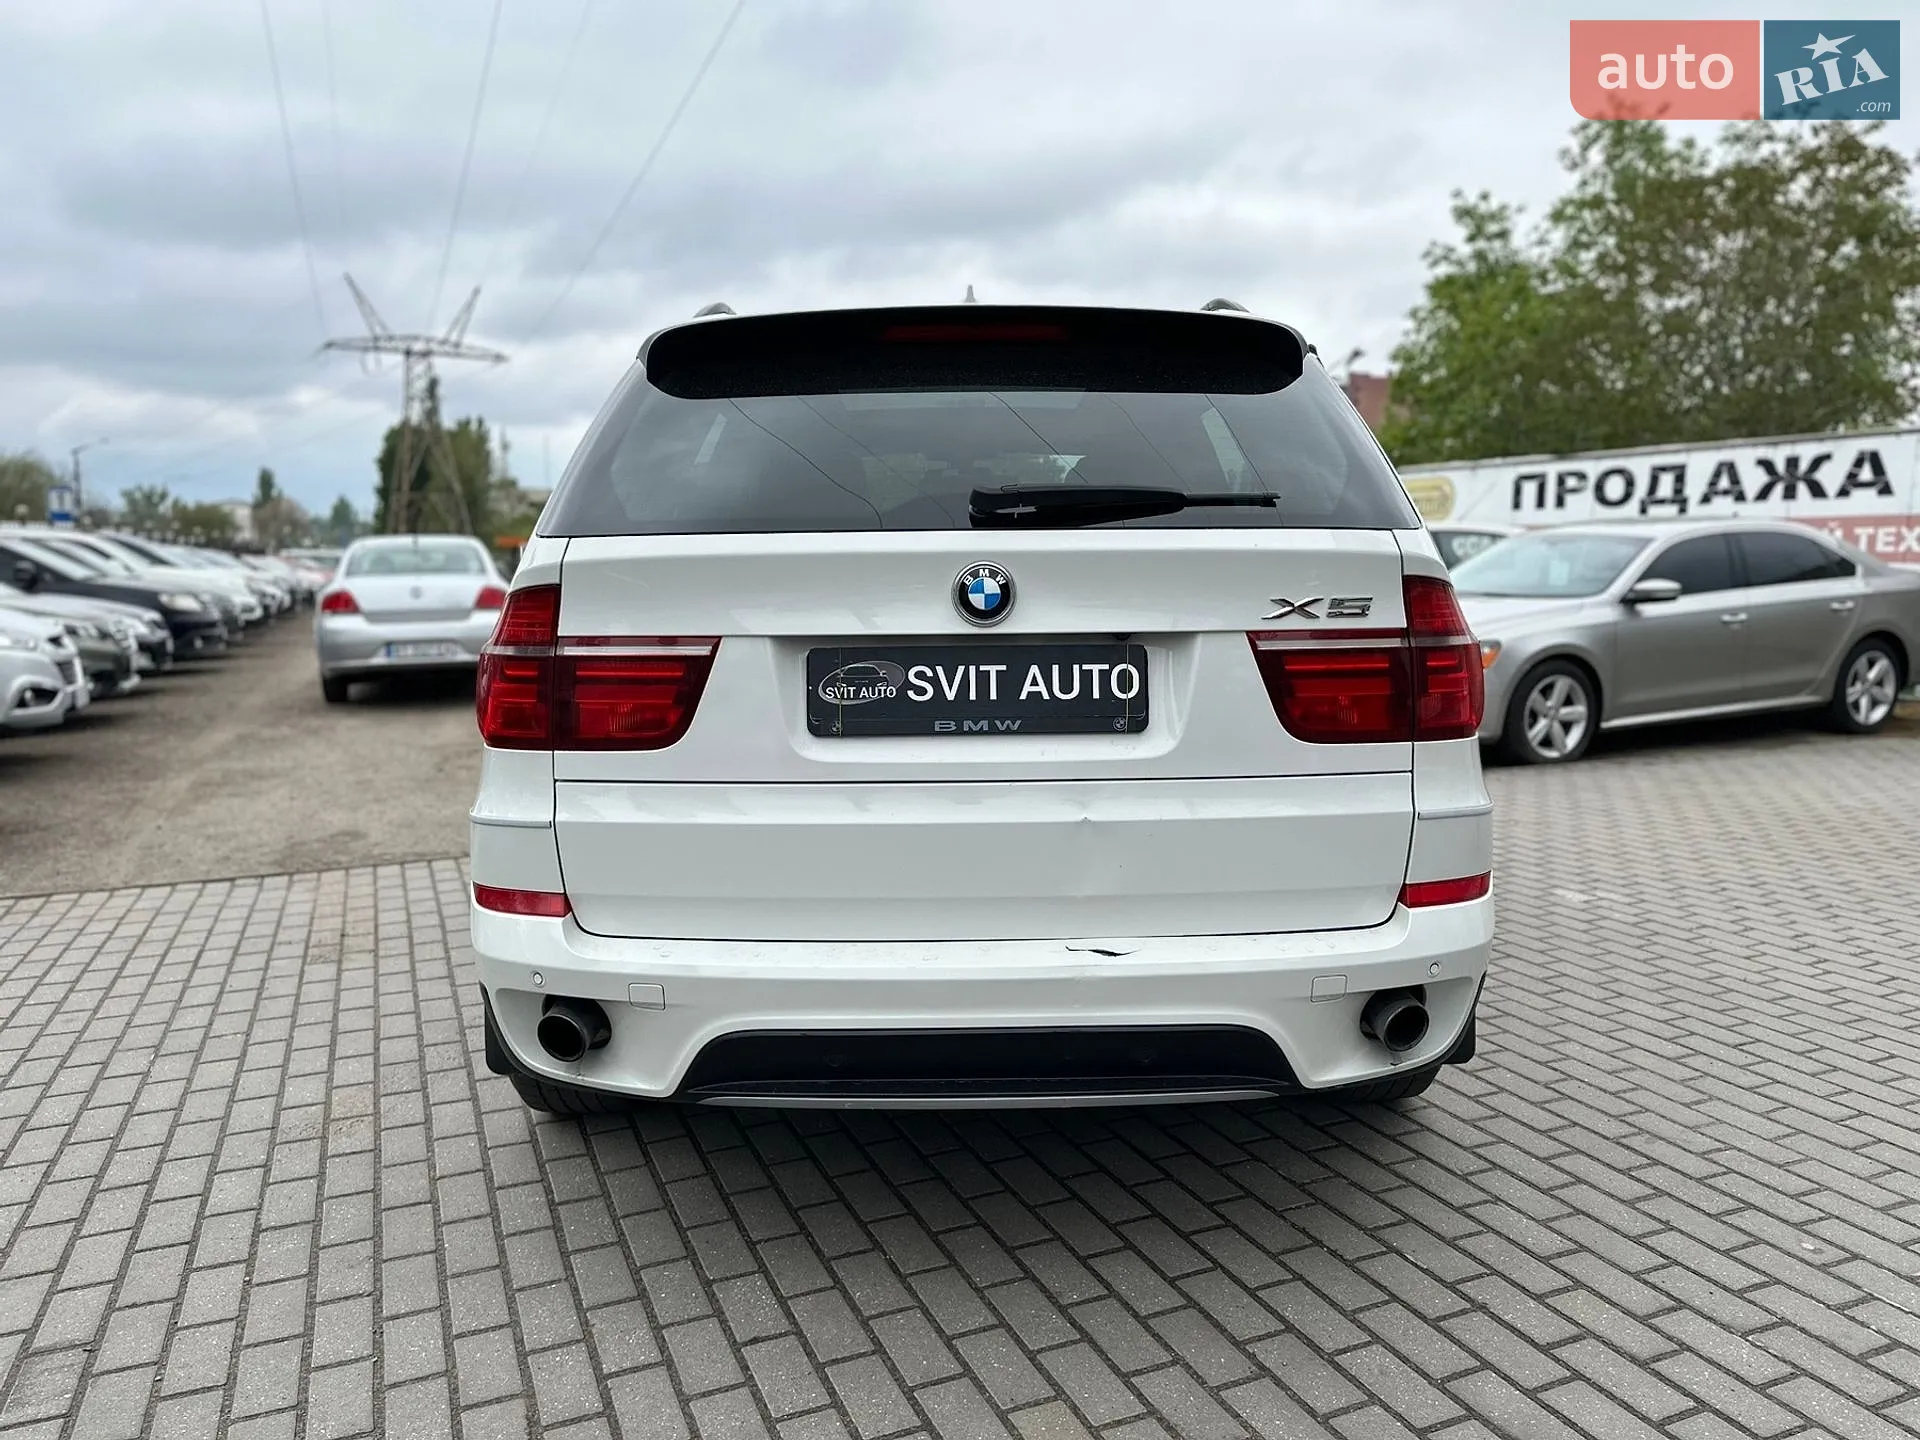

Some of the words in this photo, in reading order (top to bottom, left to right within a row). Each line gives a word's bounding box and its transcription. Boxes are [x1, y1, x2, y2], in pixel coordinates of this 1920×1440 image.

[1512, 450, 1894, 515] ПРОДАЖА
[963, 568, 1007, 586] BMW
[1260, 597, 1373, 619] X5
[907, 665, 1007, 701] SVIT
[1019, 663, 1140, 700] AUTO
[825, 686, 856, 699] SVIT
[860, 686, 896, 698] AUTO
[934, 719, 1022, 731] BMW
